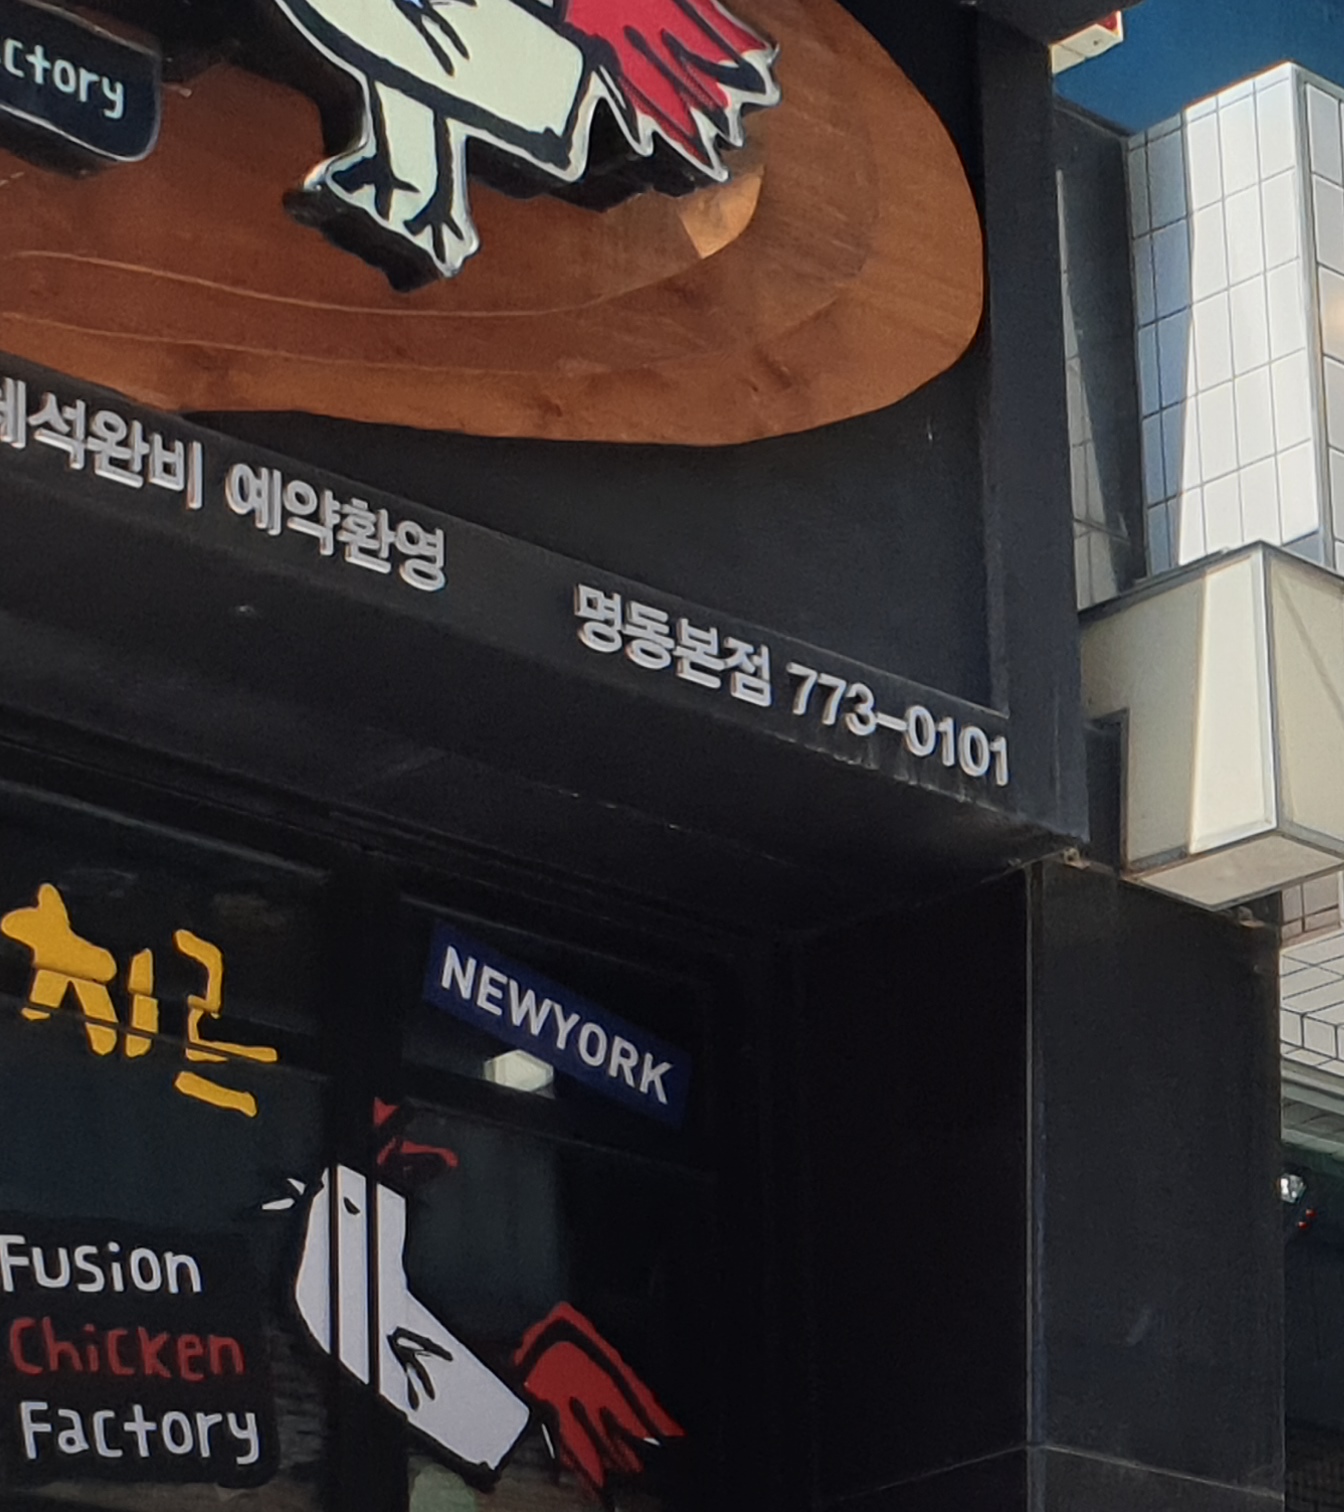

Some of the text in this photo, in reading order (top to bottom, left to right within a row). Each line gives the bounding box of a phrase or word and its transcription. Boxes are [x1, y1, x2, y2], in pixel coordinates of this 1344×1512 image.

[225, 462, 447, 592] 예약환영
[573, 582, 774, 708] 명동본점
[786, 661, 1010, 788] 773-0101
[440, 942, 671, 1105] NEWYORK
[0, 1232, 202, 1294] Fusion
[9, 1317, 245, 1380] Chicken
[20, 1399, 260, 1465] Factory
